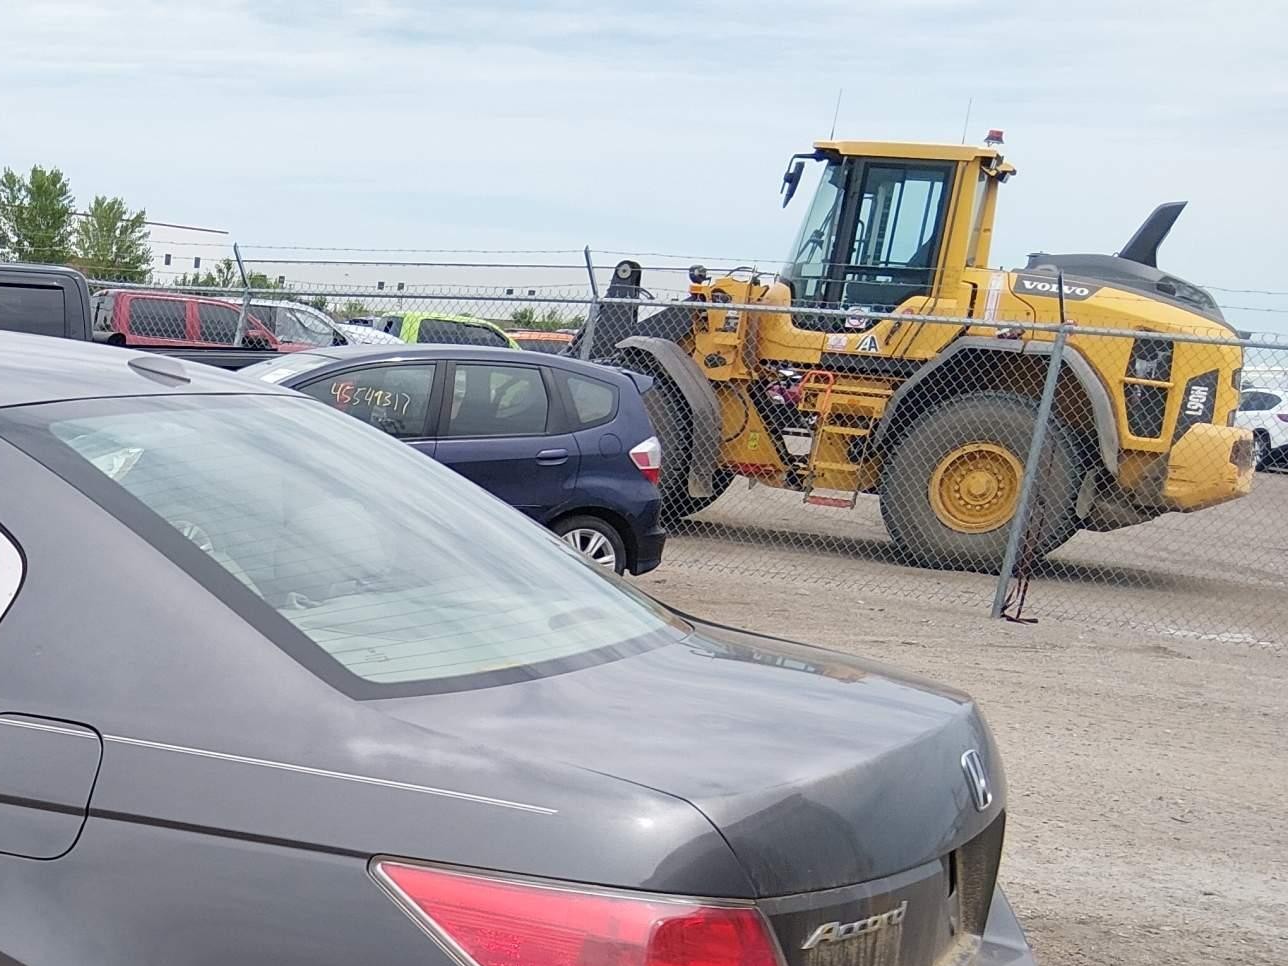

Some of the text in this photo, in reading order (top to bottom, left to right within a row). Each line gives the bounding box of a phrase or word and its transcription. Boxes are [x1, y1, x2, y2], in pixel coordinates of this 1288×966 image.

[1023, 280, 1089, 296] VOLVO
[1185, 385, 1209, 416] L90H
[800, 900, 909, 950] Accord
